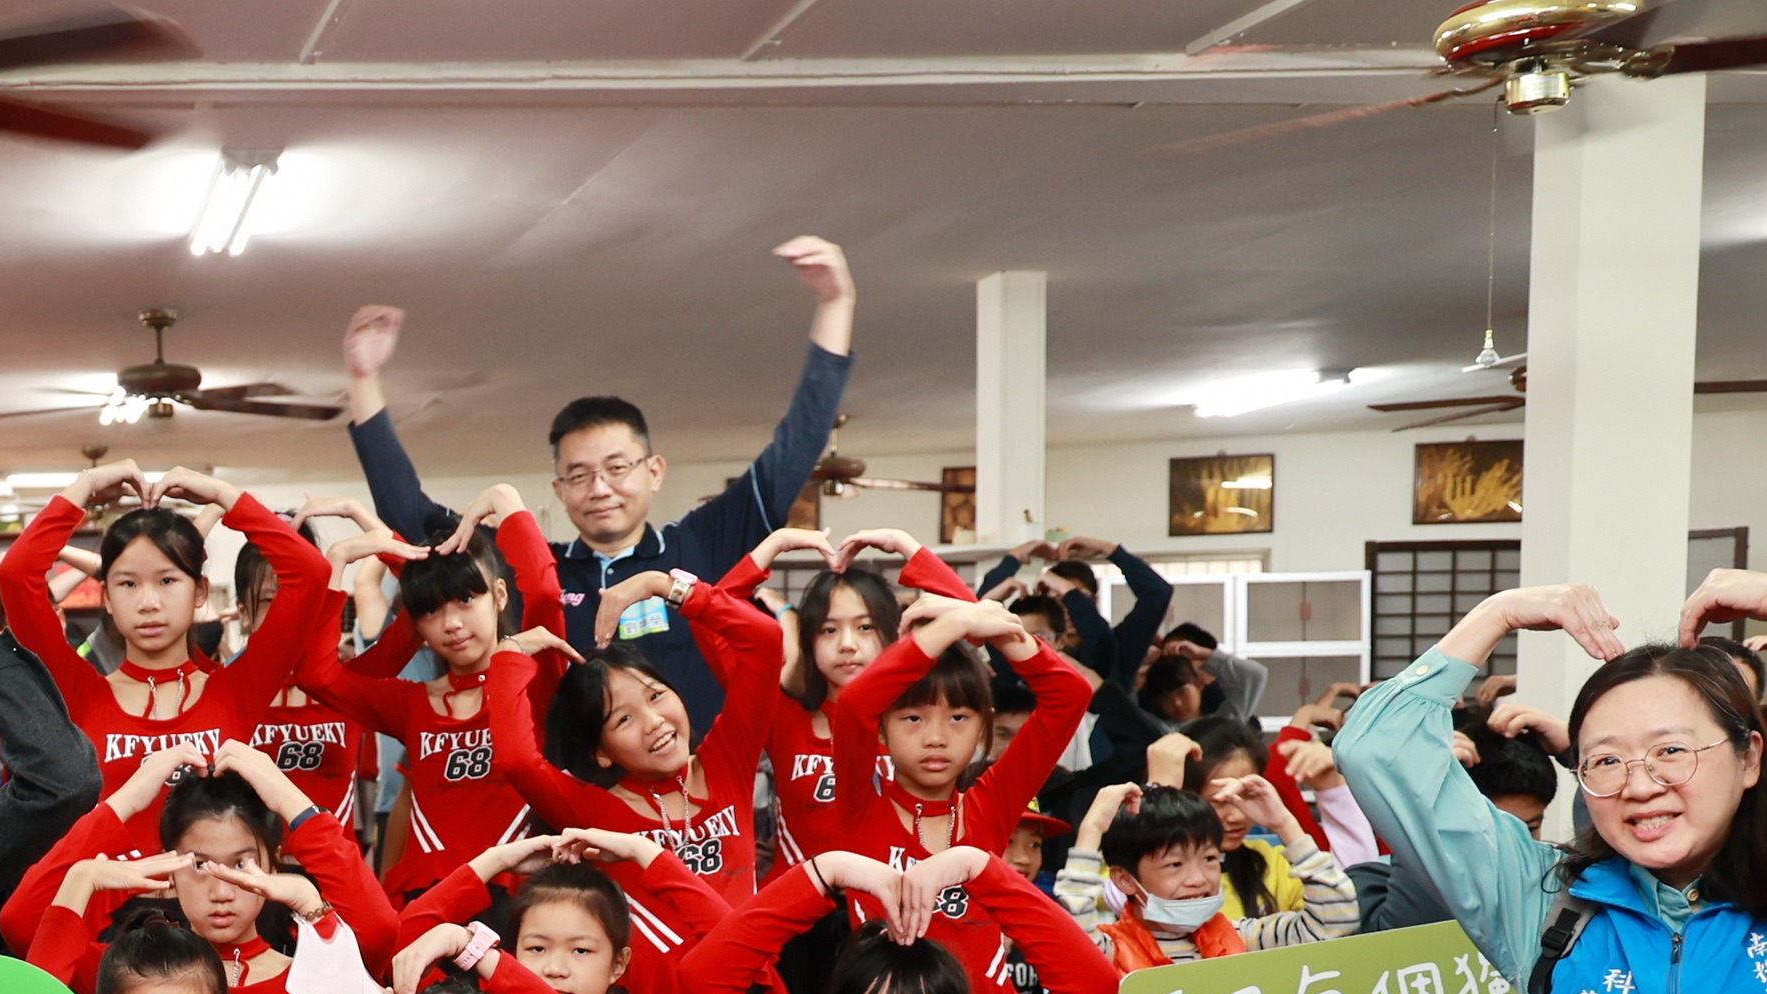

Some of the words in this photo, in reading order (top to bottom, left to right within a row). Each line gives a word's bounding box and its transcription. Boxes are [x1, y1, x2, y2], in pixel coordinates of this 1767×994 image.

[276, 741, 325, 771] 68
[444, 746, 493, 782] 68
[932, 884, 969, 919] 8
